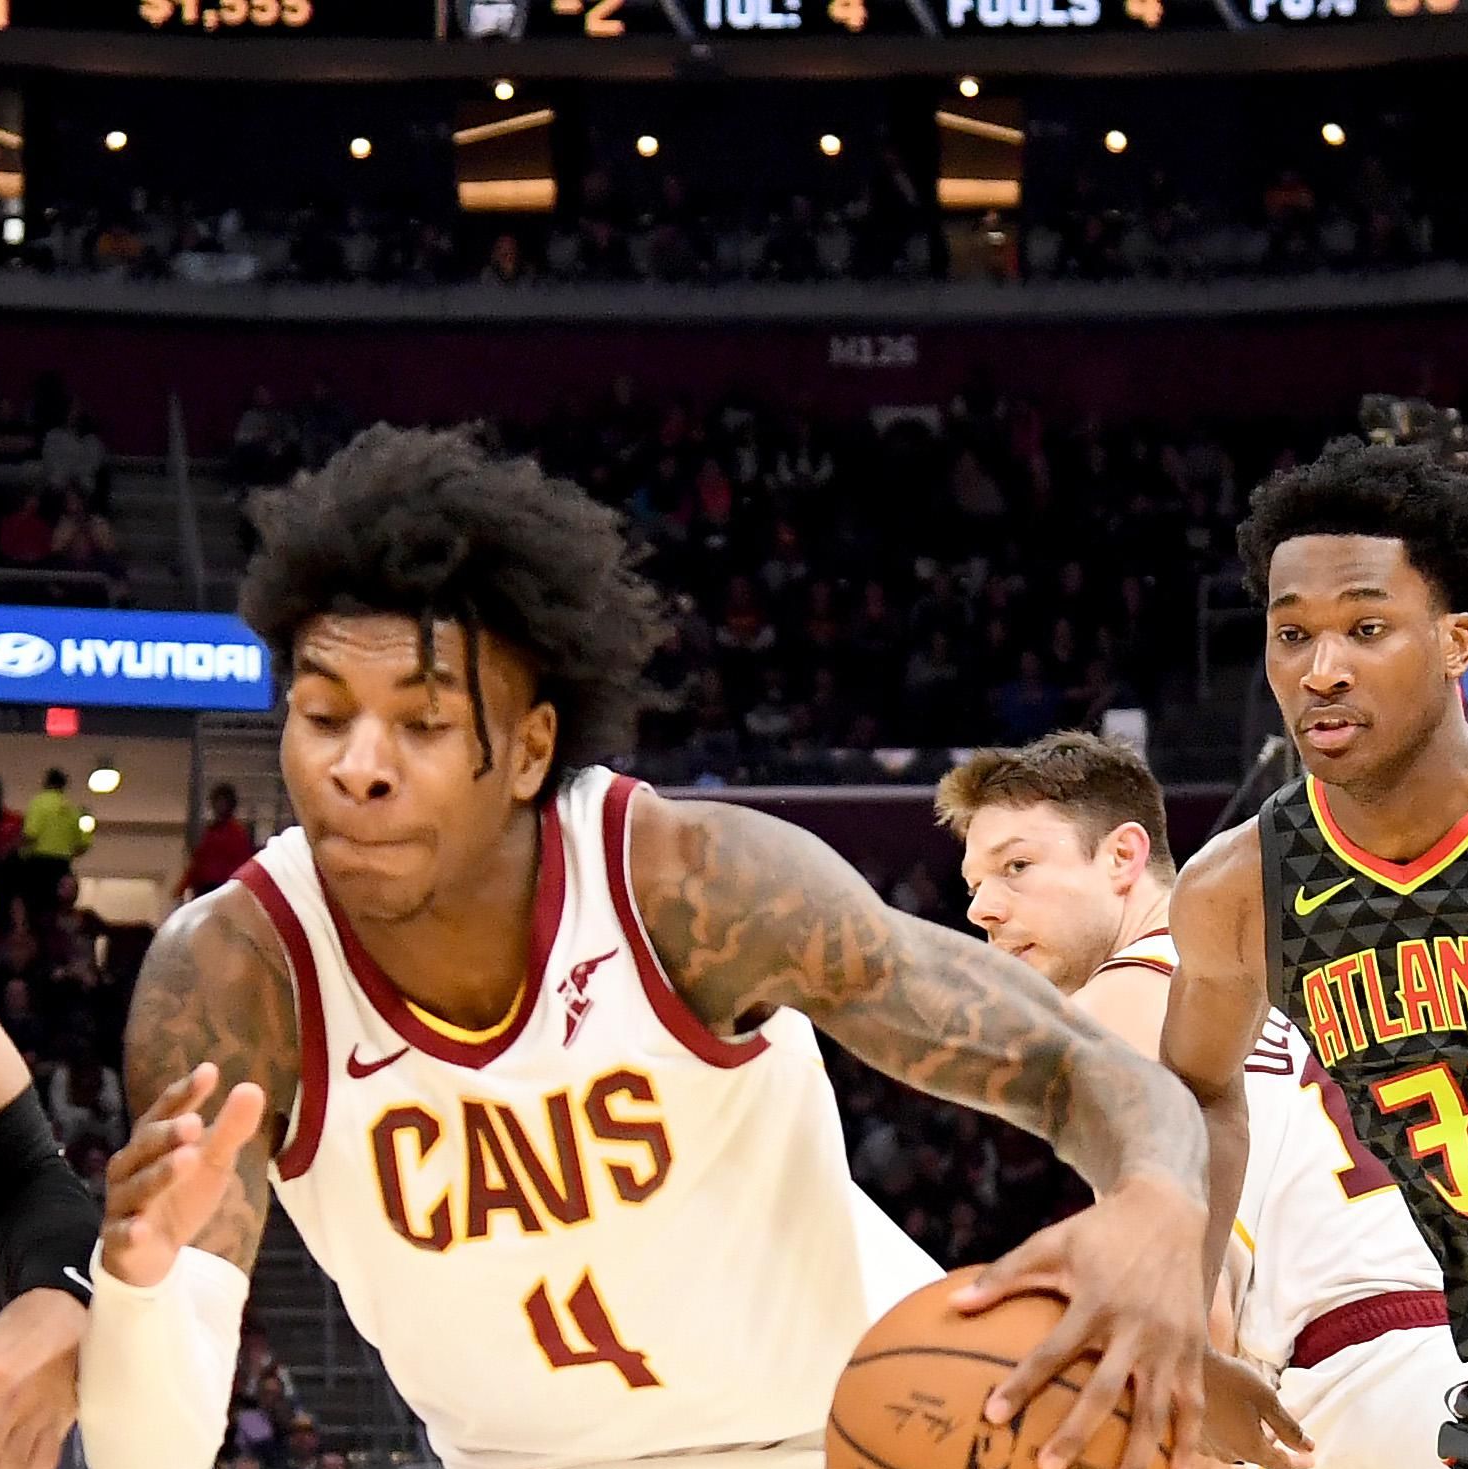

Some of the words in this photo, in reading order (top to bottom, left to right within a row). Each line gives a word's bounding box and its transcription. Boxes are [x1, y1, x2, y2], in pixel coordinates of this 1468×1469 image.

[60, 638, 262, 683] HYUNDAI
[369, 1068, 673, 1252] CAVS
[523, 1265, 663, 1390] 4
